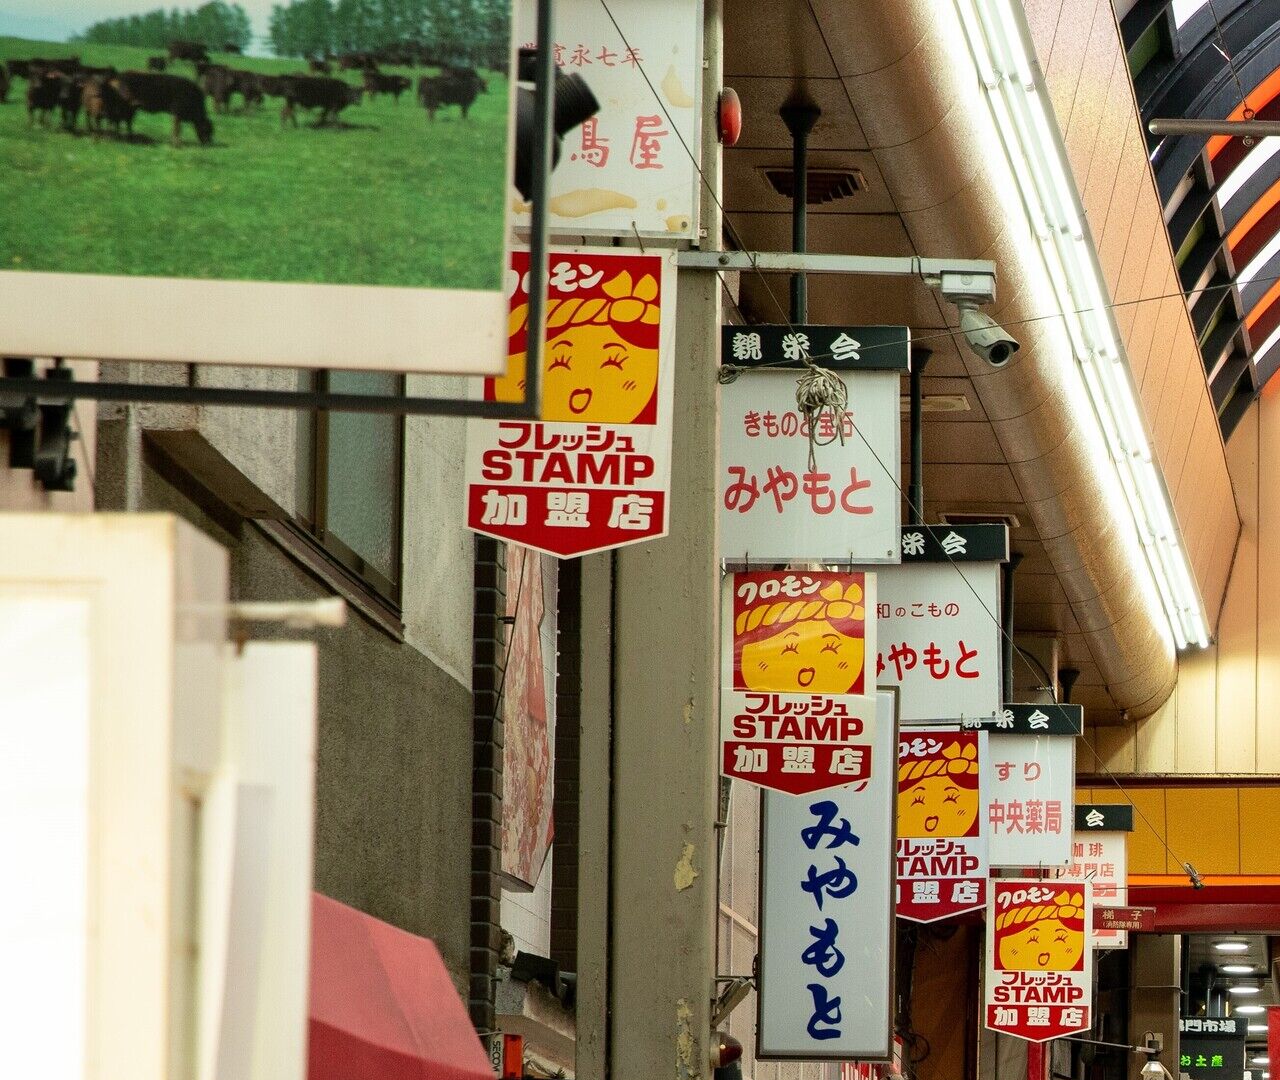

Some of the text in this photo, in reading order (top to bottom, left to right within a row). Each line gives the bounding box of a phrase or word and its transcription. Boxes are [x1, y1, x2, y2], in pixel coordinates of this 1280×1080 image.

[733, 331, 862, 361] 親栄会
[498, 423, 636, 453] フレッシュ
[482, 452, 655, 485] STAMP
[724, 465, 875, 516] みやもと
[481, 491, 654, 531] 加盟店
[738, 576, 821, 604] クロモン
[876, 641, 980, 680] やもと
[744, 694, 849, 716] フレッシュ
[734, 715, 864, 741] STAMP
[733, 747, 864, 775] 加盟店
[998, 886, 1055, 907] クロモン
[800, 800, 861, 1040] みやもと
[1001, 971, 1073, 985] フレッシュ
[993, 985, 1084, 1004] STAMP
[993, 1007, 1083, 1028] 加盟店
